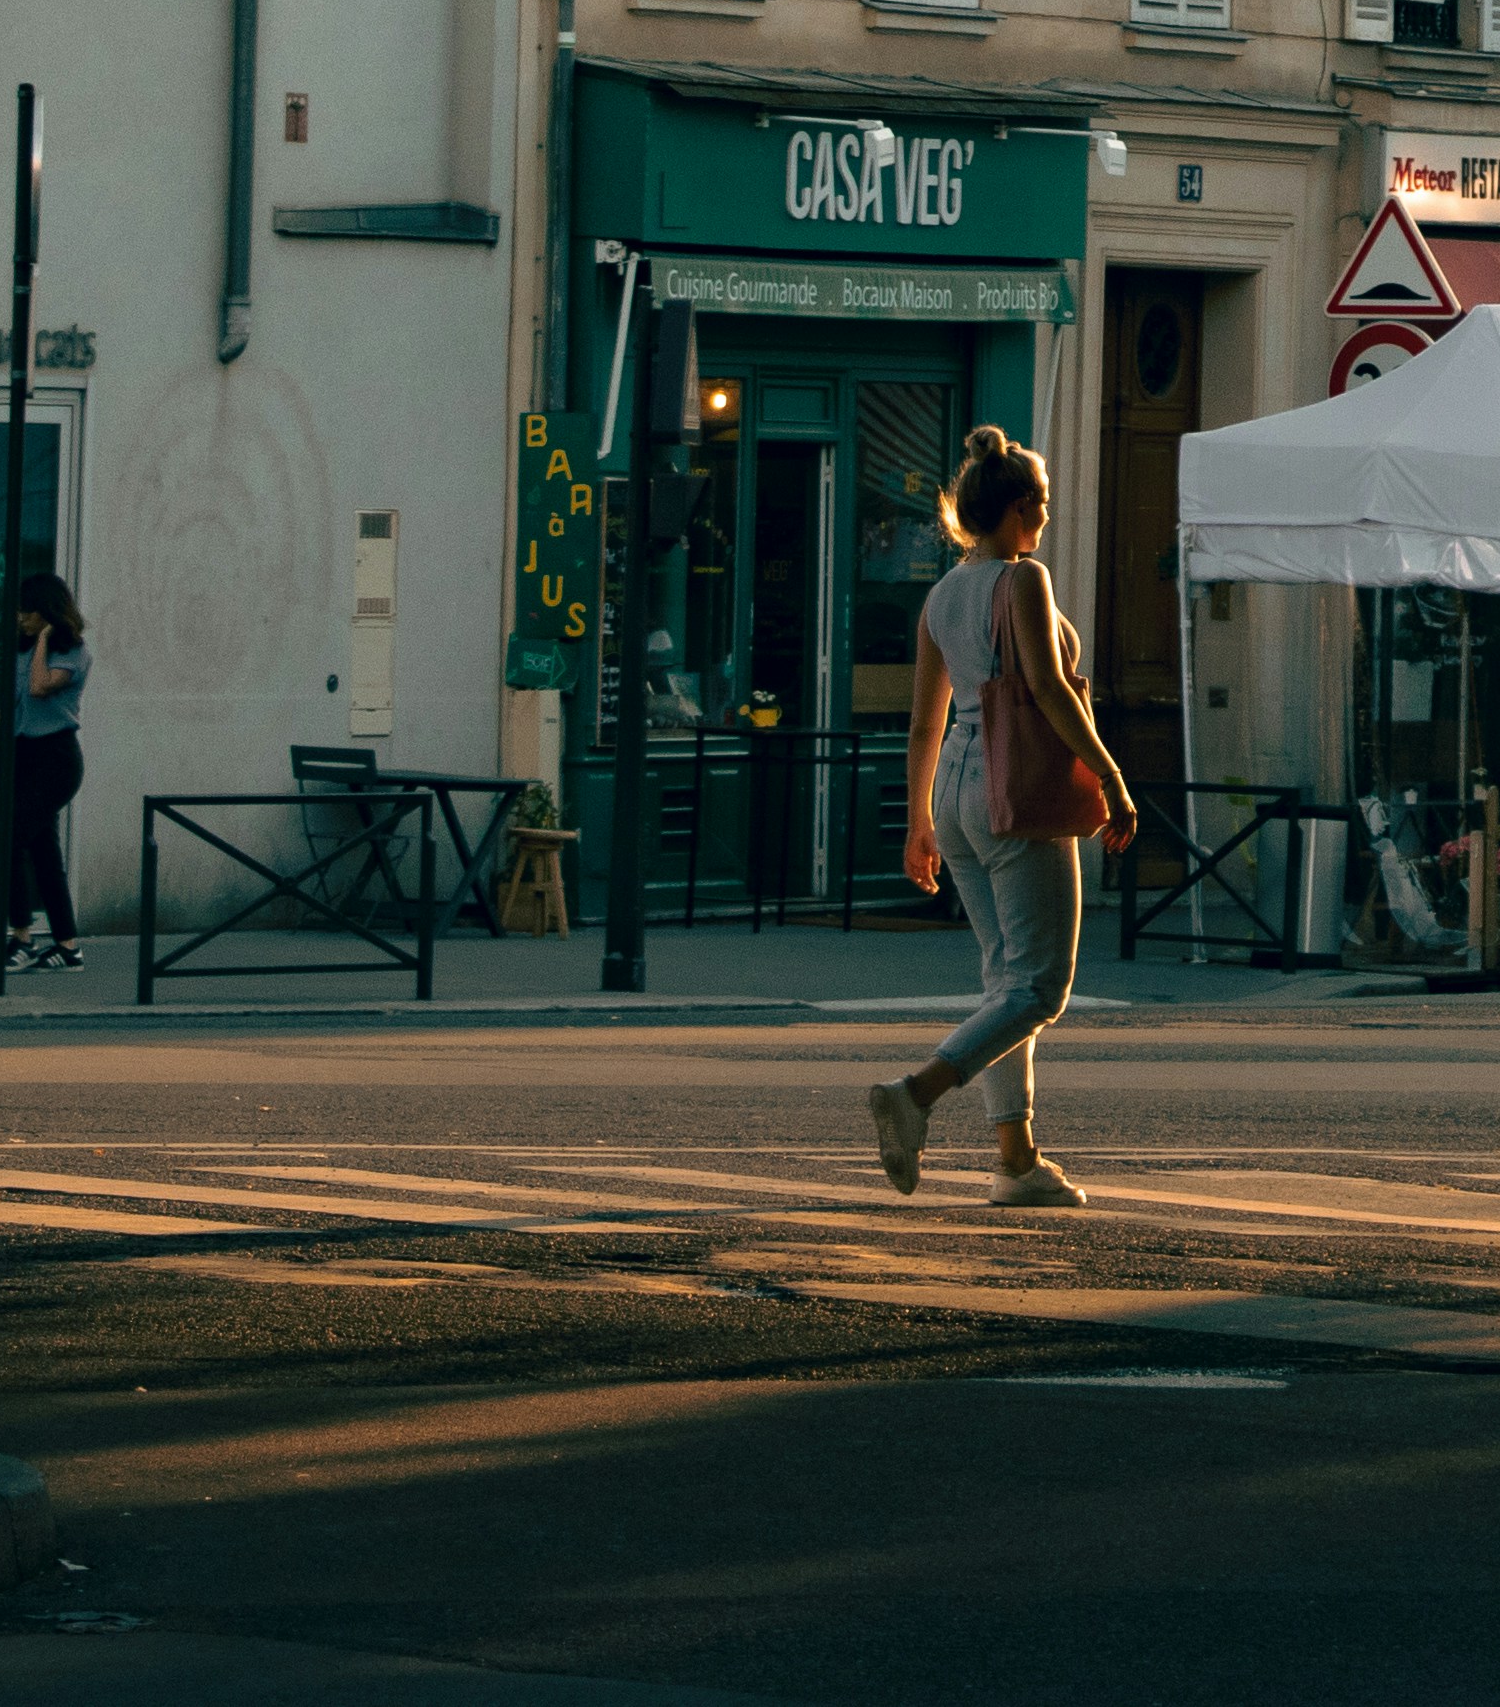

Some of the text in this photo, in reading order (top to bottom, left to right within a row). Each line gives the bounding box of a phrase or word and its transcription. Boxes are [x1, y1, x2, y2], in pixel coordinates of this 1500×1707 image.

[786, 131, 884, 224] CASA
[1181, 168, 1200, 198] 54
[1389, 156, 1456, 192] Meteor
[667, 269, 1059, 312] Cuisine Gourmande Bocaux Maison Produits Bio
[547, 512, 565, 537] à
[523, 540, 587, 638] JUS
